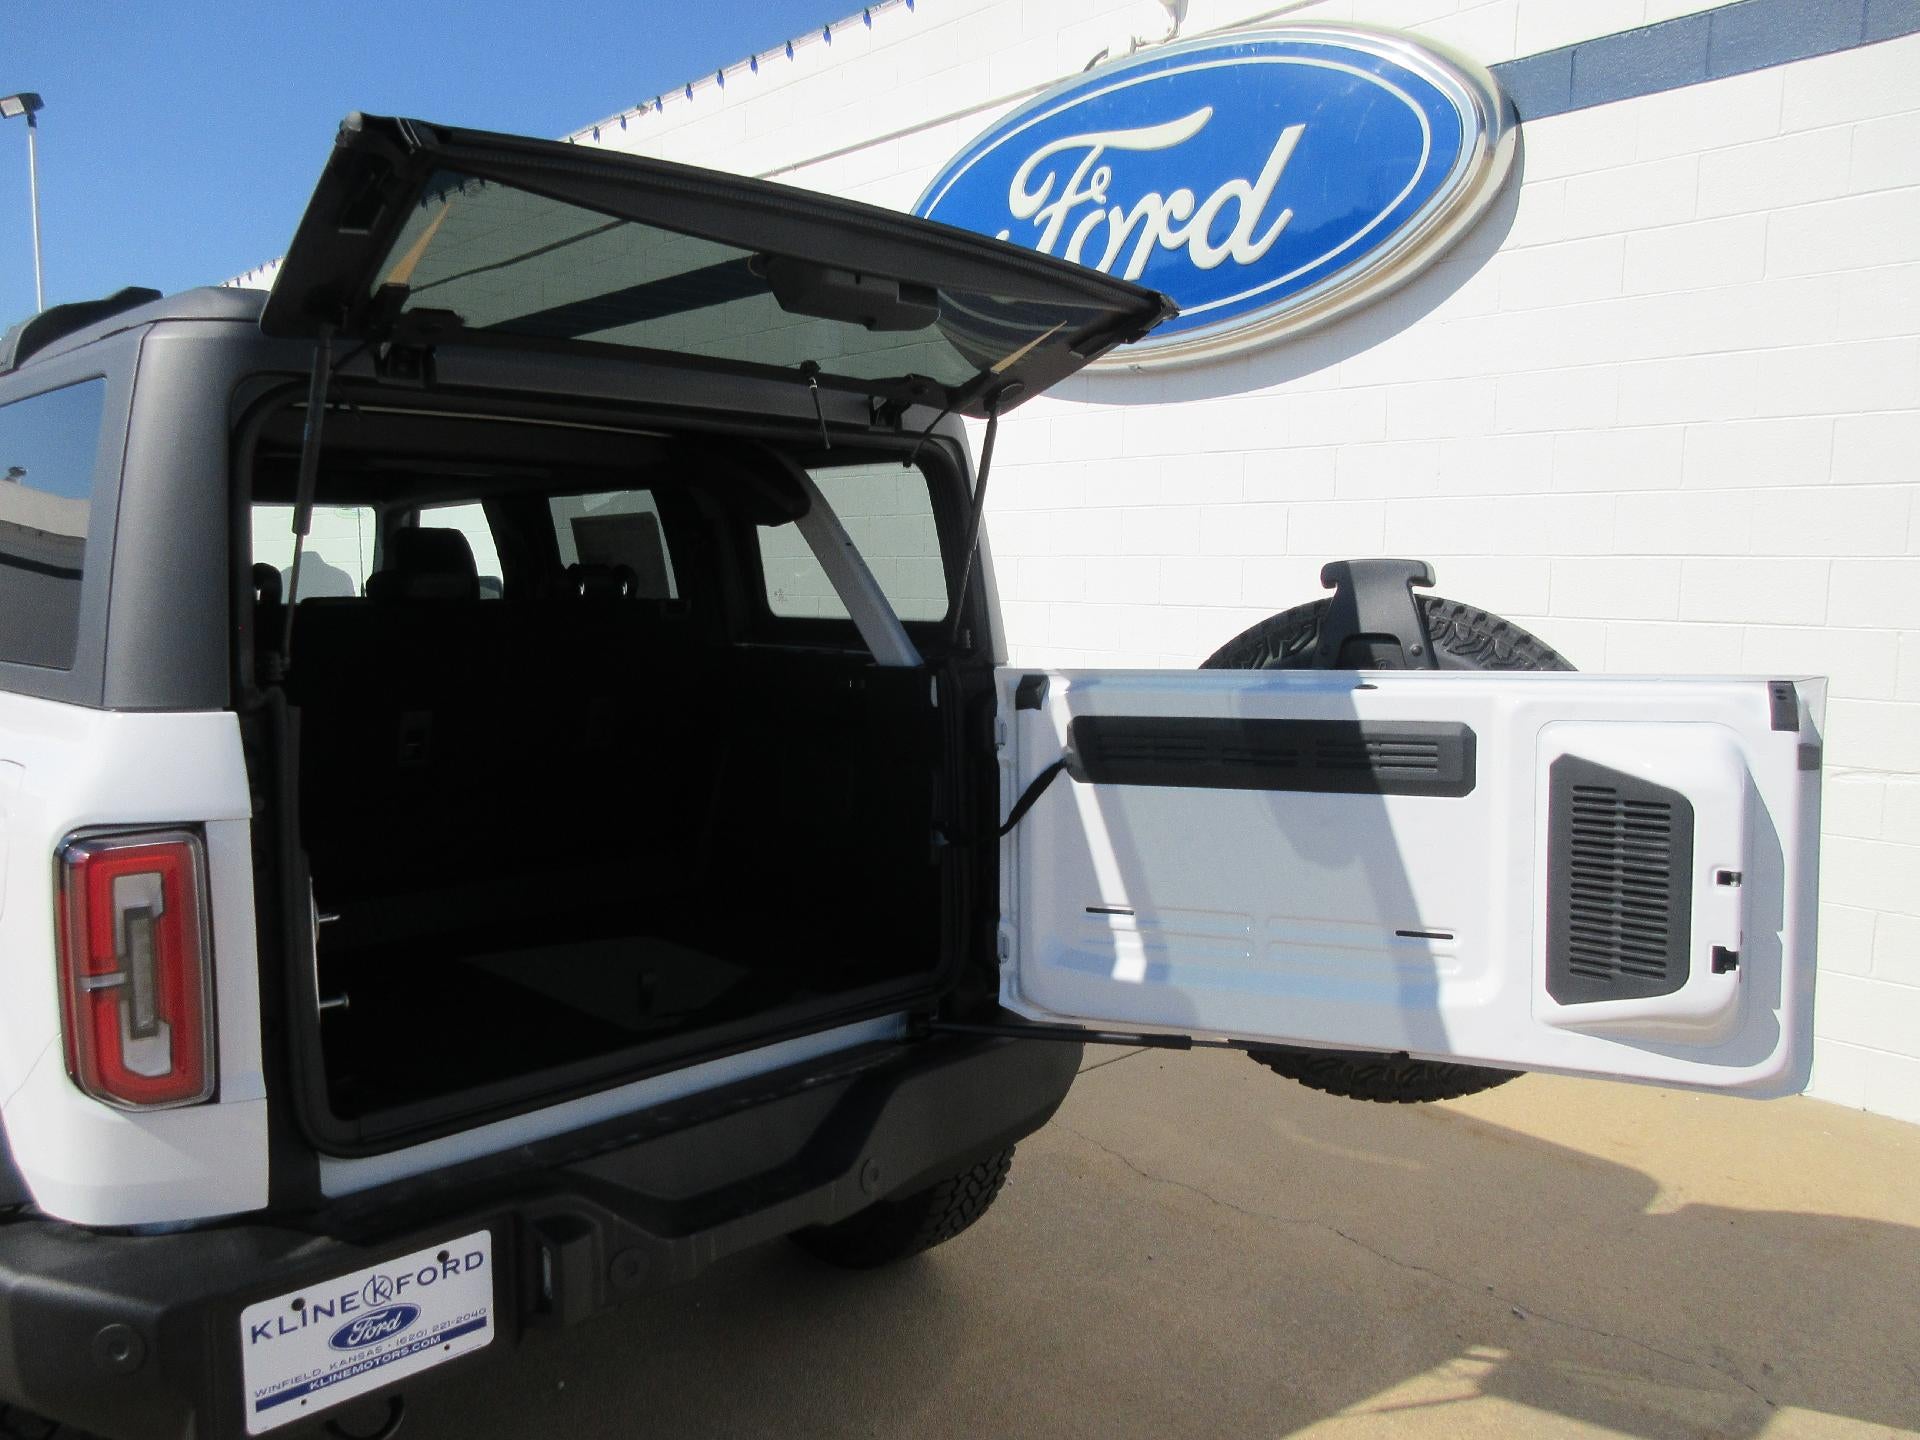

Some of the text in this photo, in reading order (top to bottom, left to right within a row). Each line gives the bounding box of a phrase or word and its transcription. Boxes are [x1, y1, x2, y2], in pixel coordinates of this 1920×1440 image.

[997, 106, 1306, 281] Ford
[251, 1289, 361, 1344] KLINE
[396, 1251, 484, 1294] FORD
[347, 1311, 402, 1345] Ford
[309, 1335, 441, 1391] KLINEMOTORS.COM
[329, 1345, 383, 1370] KANSAS
